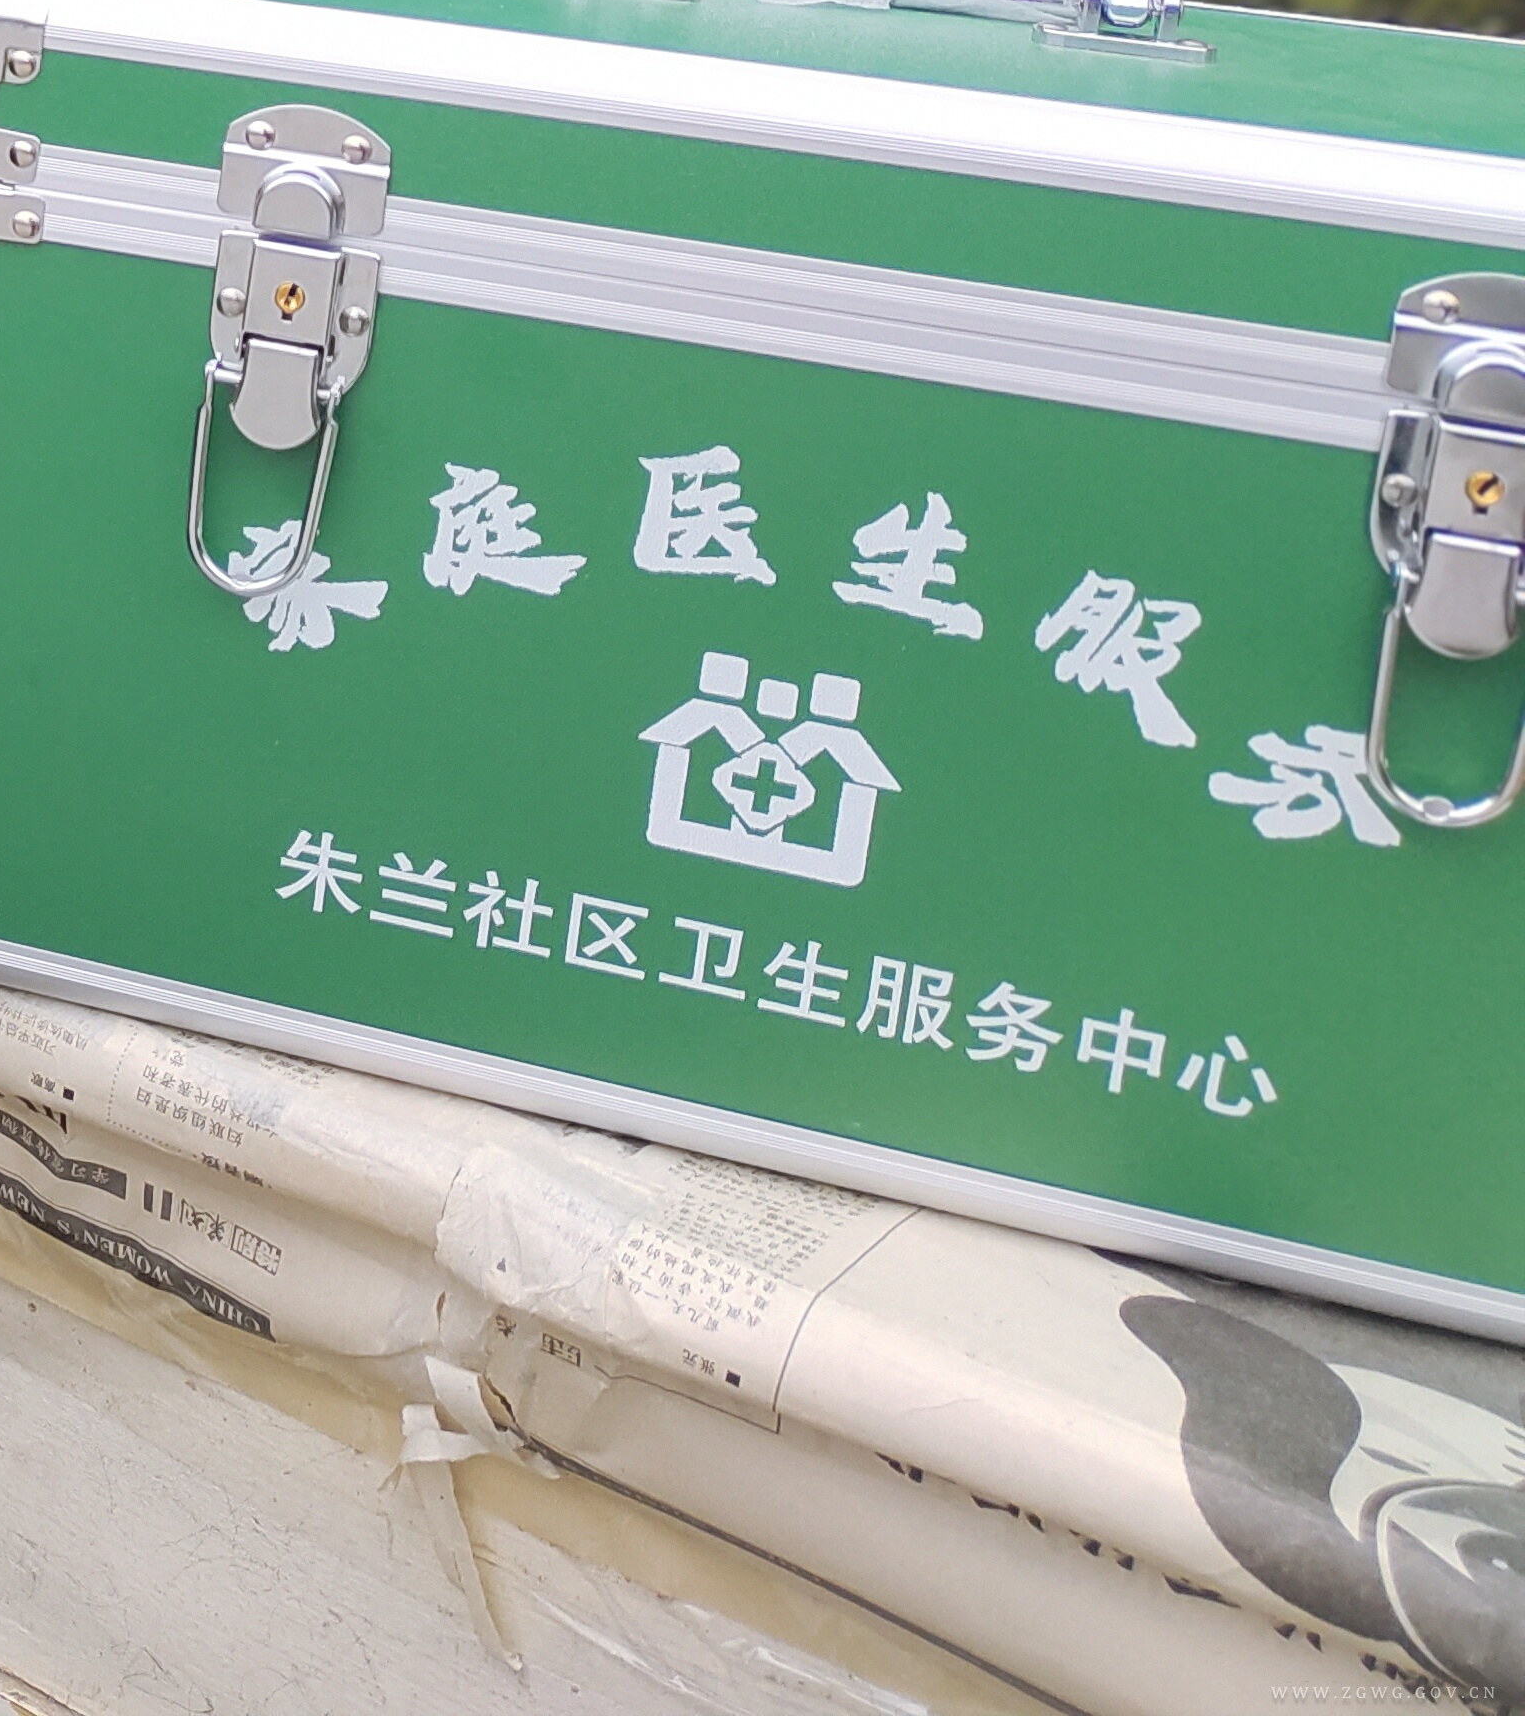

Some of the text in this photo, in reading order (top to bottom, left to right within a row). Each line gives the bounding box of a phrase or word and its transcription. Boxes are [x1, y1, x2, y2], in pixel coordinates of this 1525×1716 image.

[230, 446, 1405, 846] 家庭医生服务
[276, 830, 1280, 1120] 朱兰社区卫生服务中心
[27, 1070, 58, 1094] 高歌
[133, 1087, 244, 1148] 妇联组织是妇
[55, 1216, 175, 1286] WOMEN'S
[179, 1195, 282, 1276] 特别策划
[185, 1275, 263, 1336] CHINA
[680, 1347, 718, 1376] 张元
